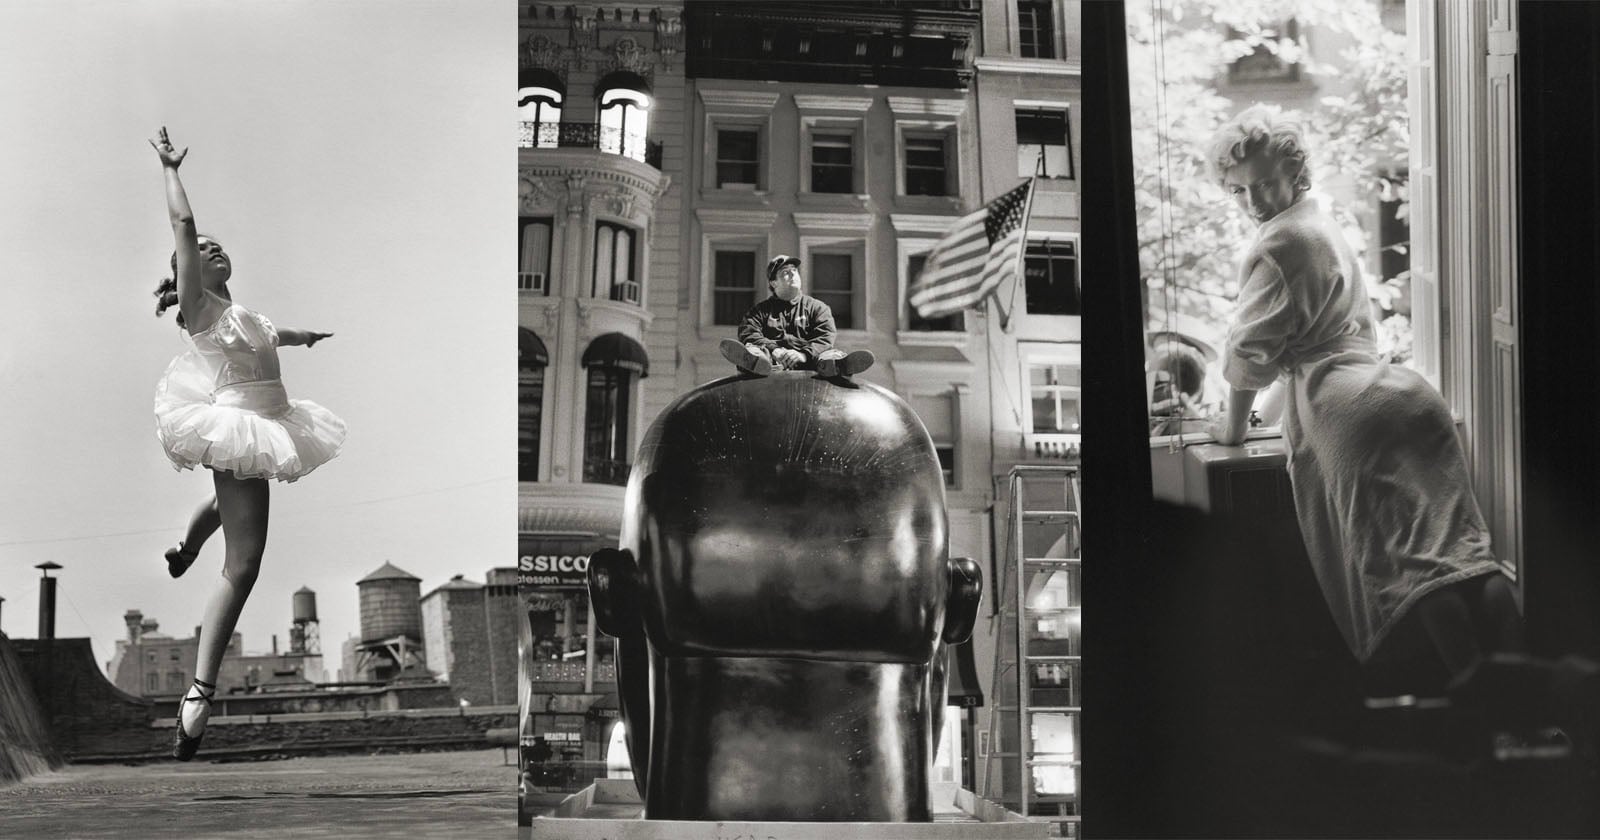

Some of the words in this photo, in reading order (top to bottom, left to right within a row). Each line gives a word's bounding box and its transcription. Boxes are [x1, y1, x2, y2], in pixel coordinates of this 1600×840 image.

[518, 555, 587, 572] SSICO
[543, 732, 567, 741] HEALTH
[568, 732, 581, 741] BAR
